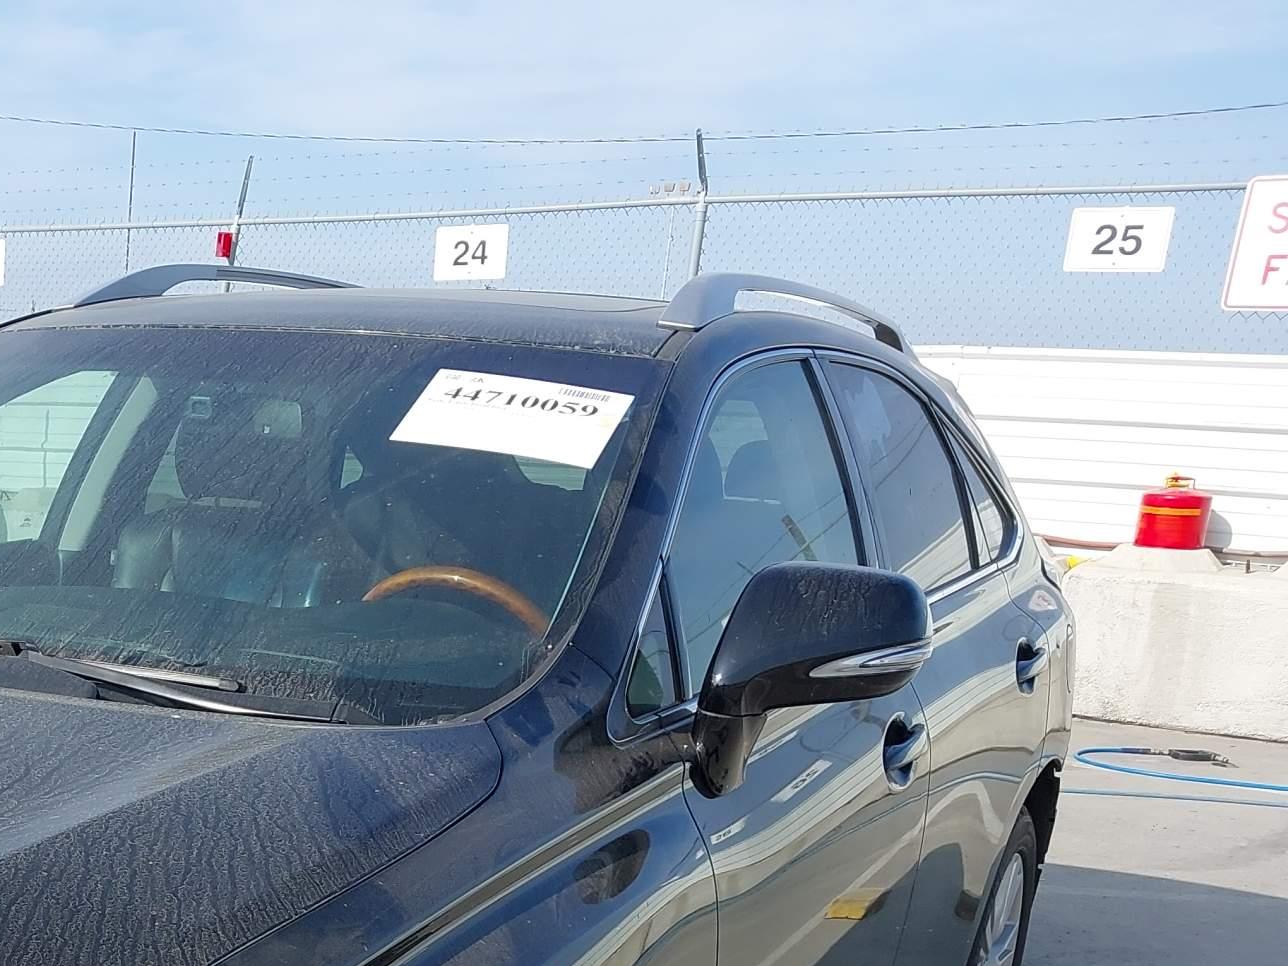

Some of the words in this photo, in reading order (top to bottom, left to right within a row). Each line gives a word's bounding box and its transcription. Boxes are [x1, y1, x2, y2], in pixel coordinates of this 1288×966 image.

[452, 240, 488, 266] 24
[1091, 224, 1144, 256] 25
[1261, 254, 1288, 285] F
[444, 386, 599, 417] 44710059
